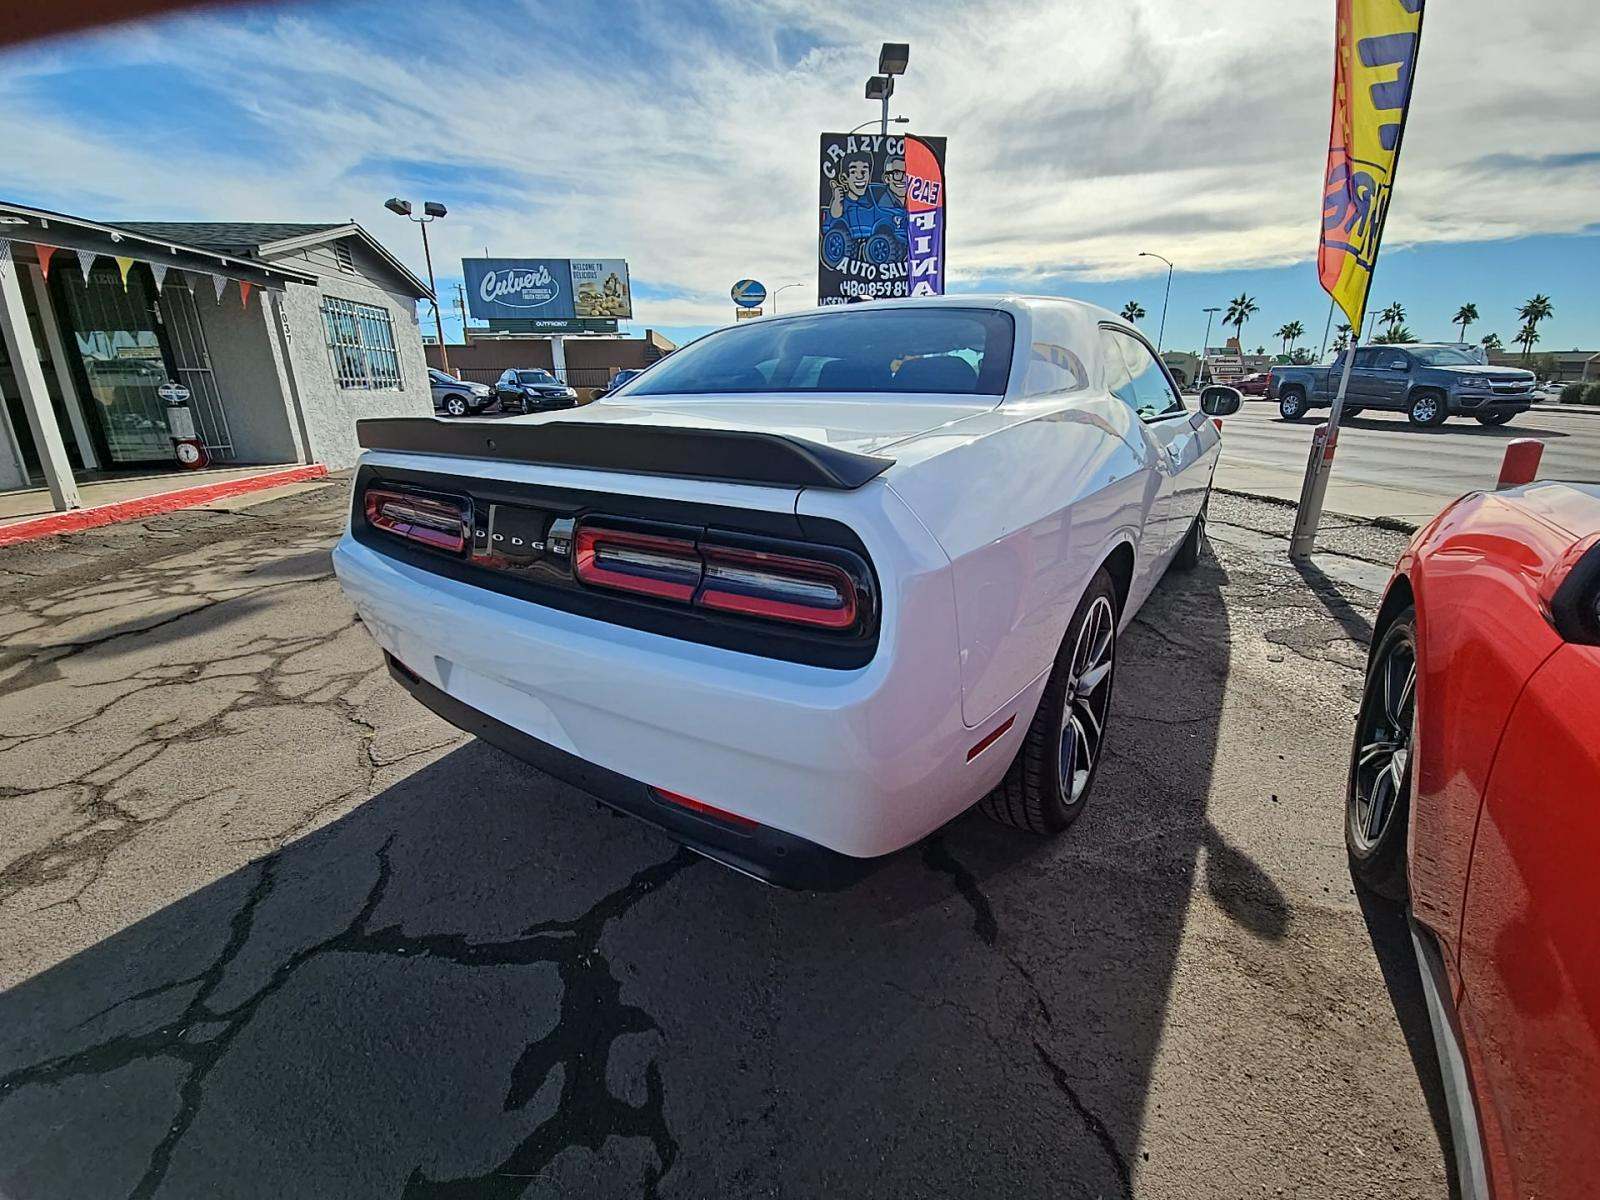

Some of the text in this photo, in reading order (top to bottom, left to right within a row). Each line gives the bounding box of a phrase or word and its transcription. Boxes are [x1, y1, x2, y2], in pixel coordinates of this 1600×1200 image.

[823, 136, 884, 179] CRAZY
[573, 263, 595, 271] WELCOME
[836, 257, 876, 280] AUTO
[481, 265, 551, 302] Culver's
[279, 301, 291, 344] 1037
[475, 529, 566, 554] DODGE
